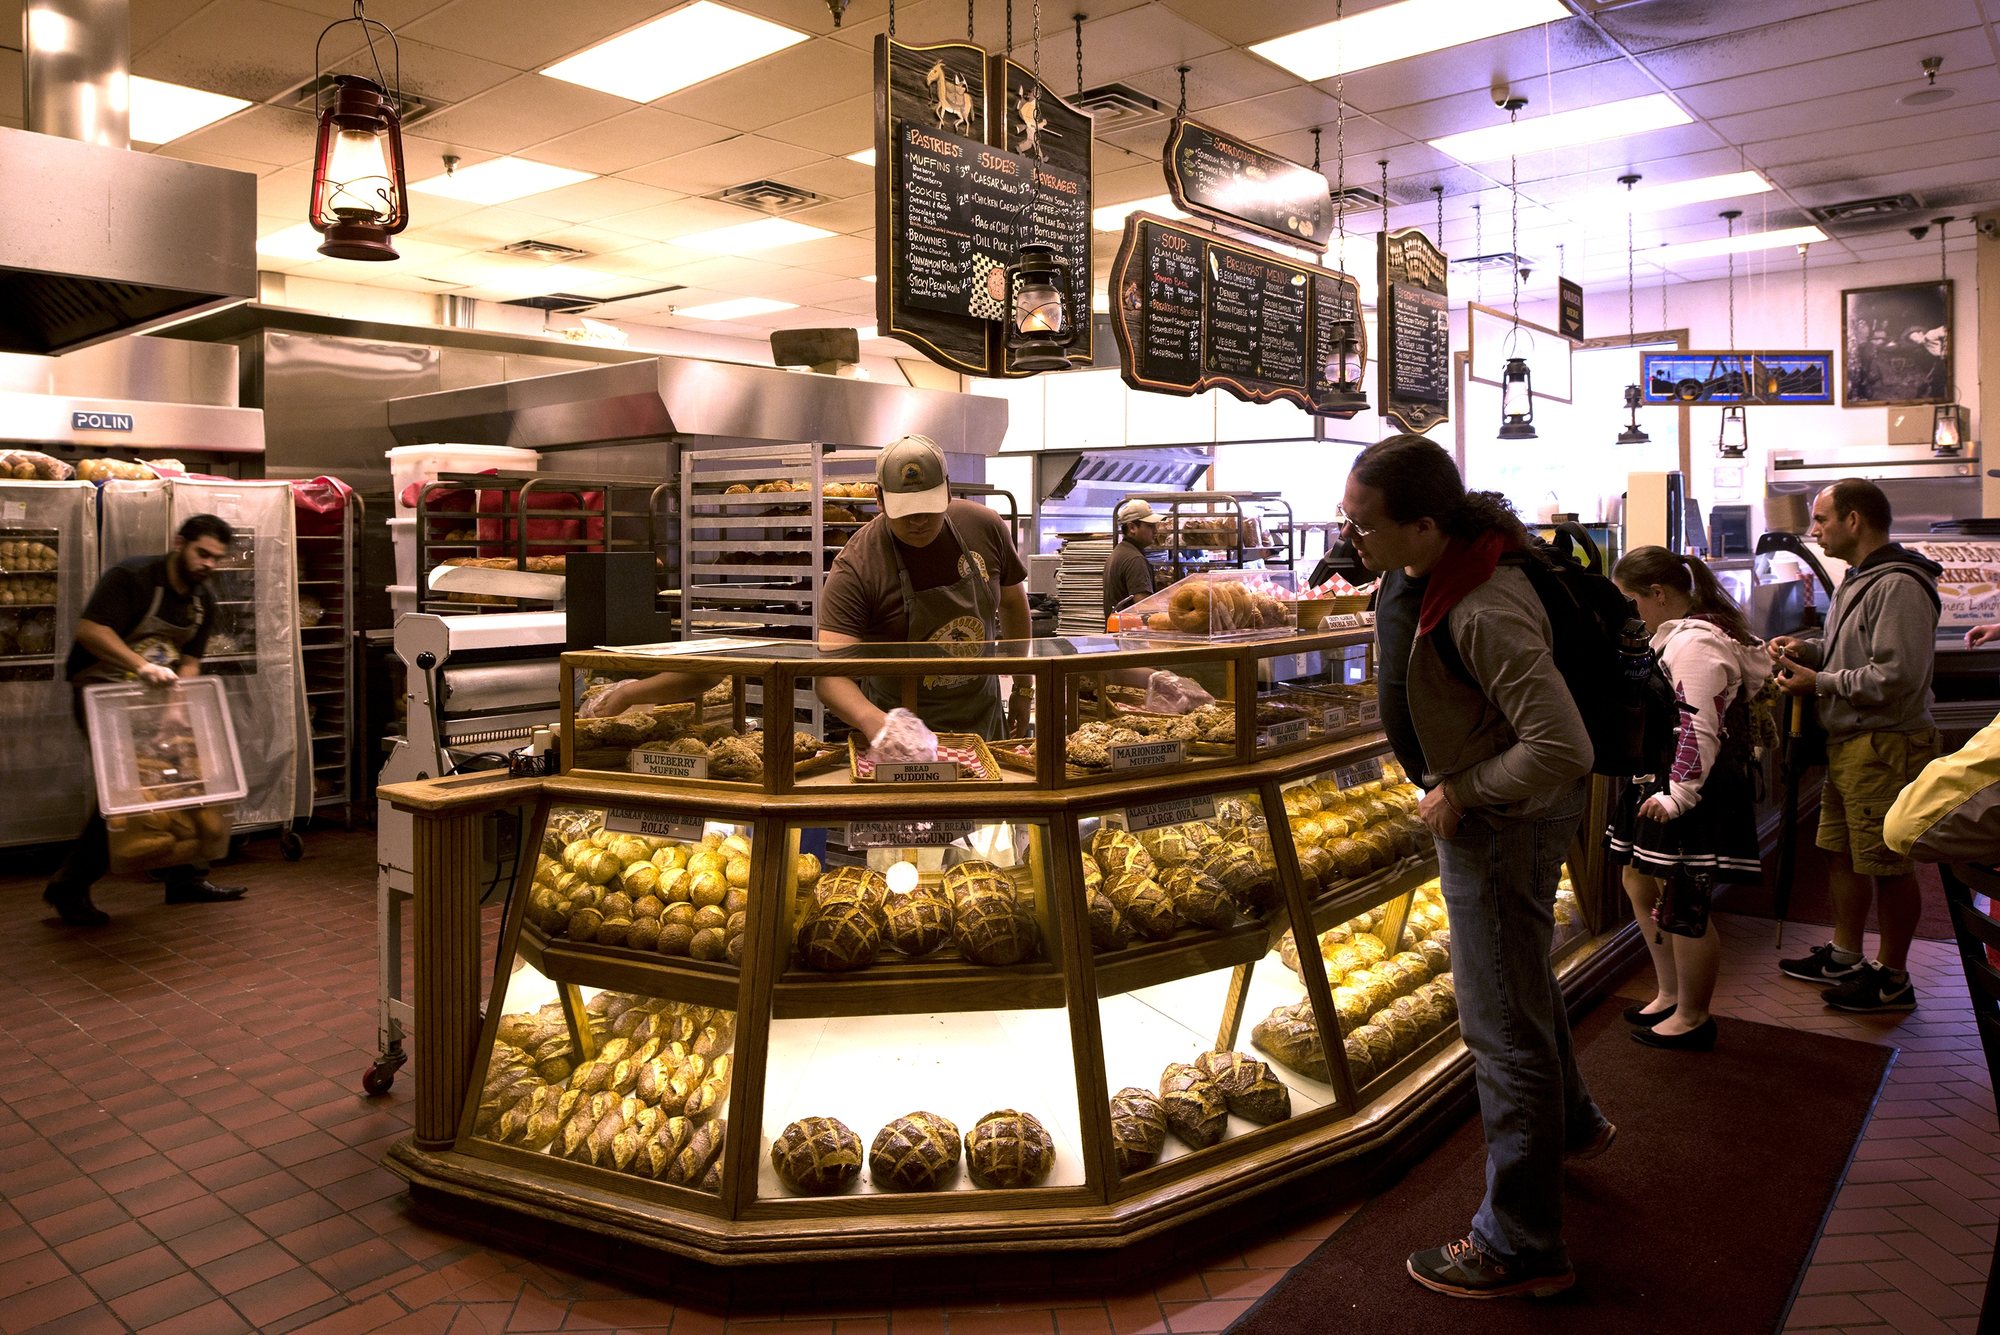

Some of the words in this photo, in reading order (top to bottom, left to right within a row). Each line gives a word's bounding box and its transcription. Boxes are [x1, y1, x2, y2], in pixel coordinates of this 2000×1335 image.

[911, 129, 959, 157] PASTRIES
[910, 152, 950, 173] MUFFINS
[981, 152, 1016, 175] SIDES
[974, 171, 1000, 191] CAESAR
[999, 179, 1018, 195] SALAD
[909, 181, 947, 202] COOKIES
[974, 192, 999, 208] CHICKEN
[974, 214, 989, 230] BAG
[908, 228, 948, 248] BROWNIES
[1034, 224, 1057, 240] BOTTLED
[975, 234, 991, 249] DILL
[992, 237, 1014, 254] PICKE
[1161, 233, 1187, 253] SOUP
[909, 252, 941, 270] CINNAMON
[1154, 246, 1171, 259] CLAM
[1172, 252, 1197, 266] CHOWDER
[1226, 255, 1264, 278] BREAKFAST
[1266, 268, 1288, 285] MENU
[1219, 286, 1240, 300] DENVER
[77, 413, 129, 429] POLIN
[1936, 567, 1986, 583] AKERY
[1116, 743, 1178, 759] MARIONBERRY
[643, 753, 697, 769] BLUEBERRY
[1129, 755, 1166, 766] MUFFINS
[649, 765, 690, 777] MUFFINS
[893, 772, 940, 782] PUDDING
[904, 765, 929, 773] BREAD
[1129, 804, 1157, 819] ALASKAN
[1157, 799, 1191, 813] SOURDOUGH
[1146, 811, 1174, 827] LARGE
[1176, 807, 1198, 821] OVAL
[609, 808, 640, 820] ALASKAN
[641, 811, 680, 825] SOURDOUGH
[680, 815, 704, 827] BREAD
[640, 821, 670, 835] ROLLS
[854, 822, 896, 833] ALASKAN
[944, 821, 972, 833] BREAD
[873, 832, 911, 843] LARGE
[914, 832, 954, 844] ROUND
